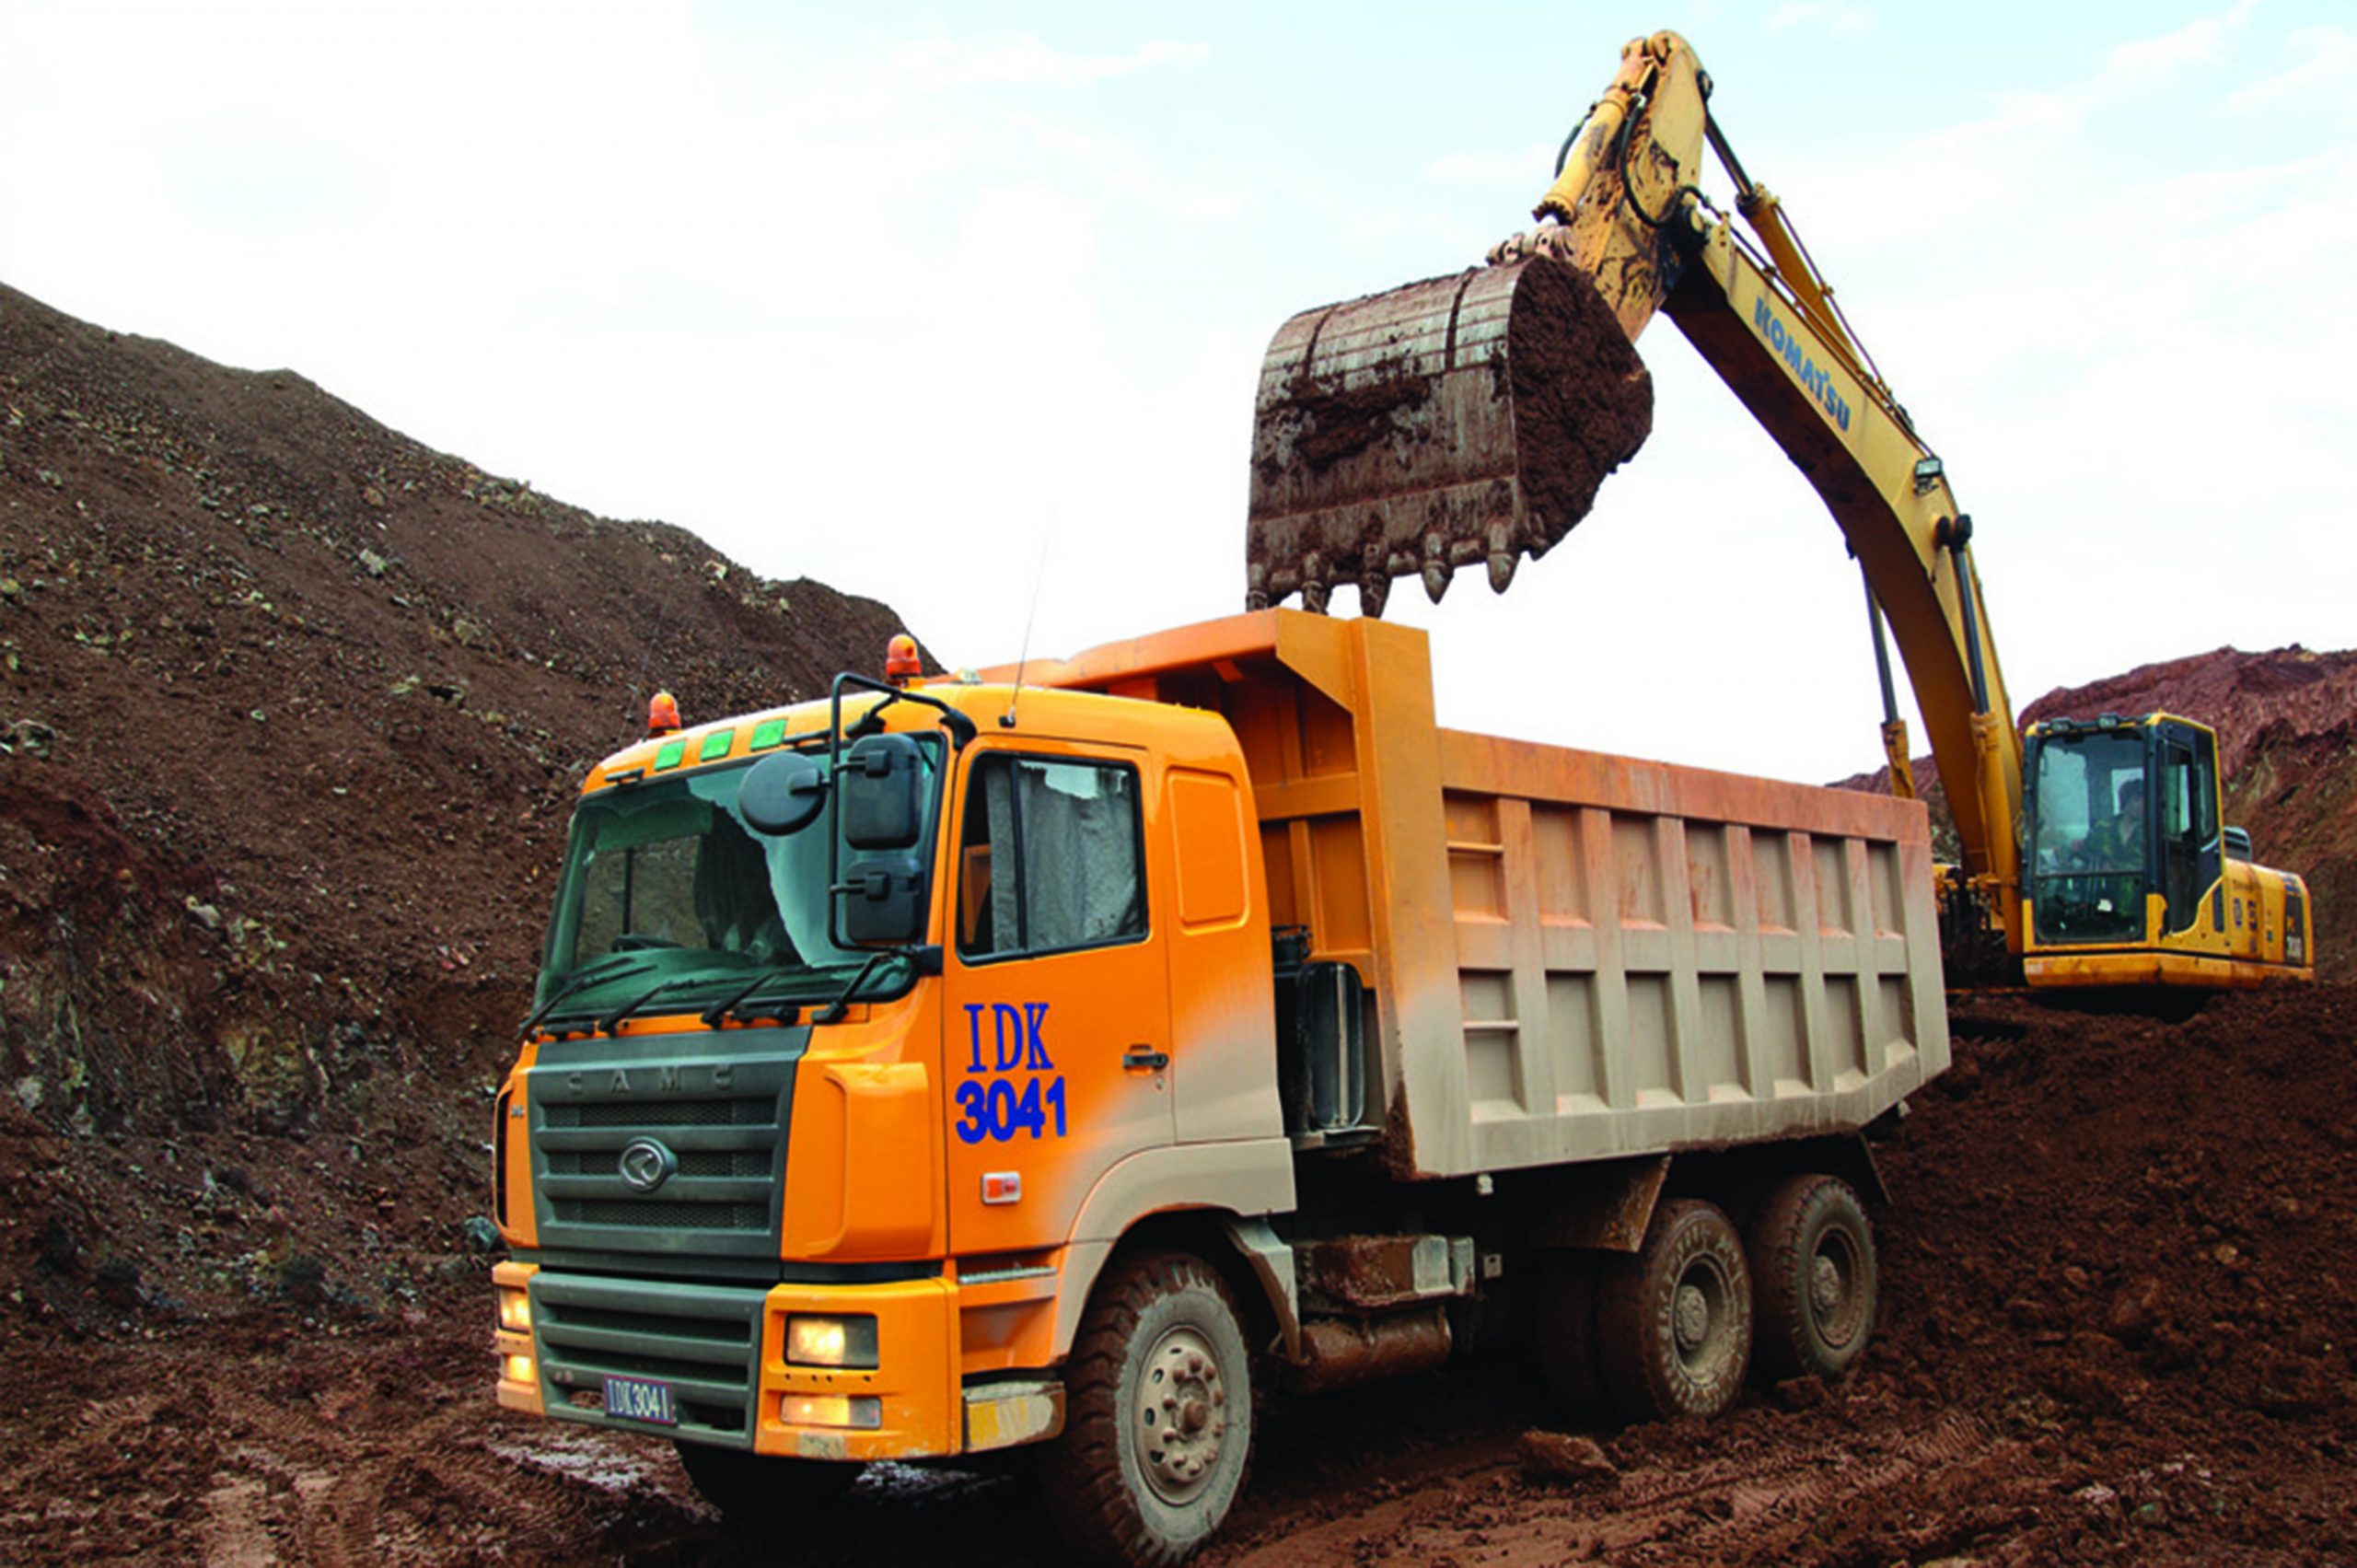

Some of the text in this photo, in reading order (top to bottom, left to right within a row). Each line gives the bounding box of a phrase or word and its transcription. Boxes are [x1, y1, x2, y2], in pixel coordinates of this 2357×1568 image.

[1754, 296, 1851, 433] KOMATSU
[963, 1002, 1054, 1073] IDK
[955, 1075, 1066, 1144] 3041
